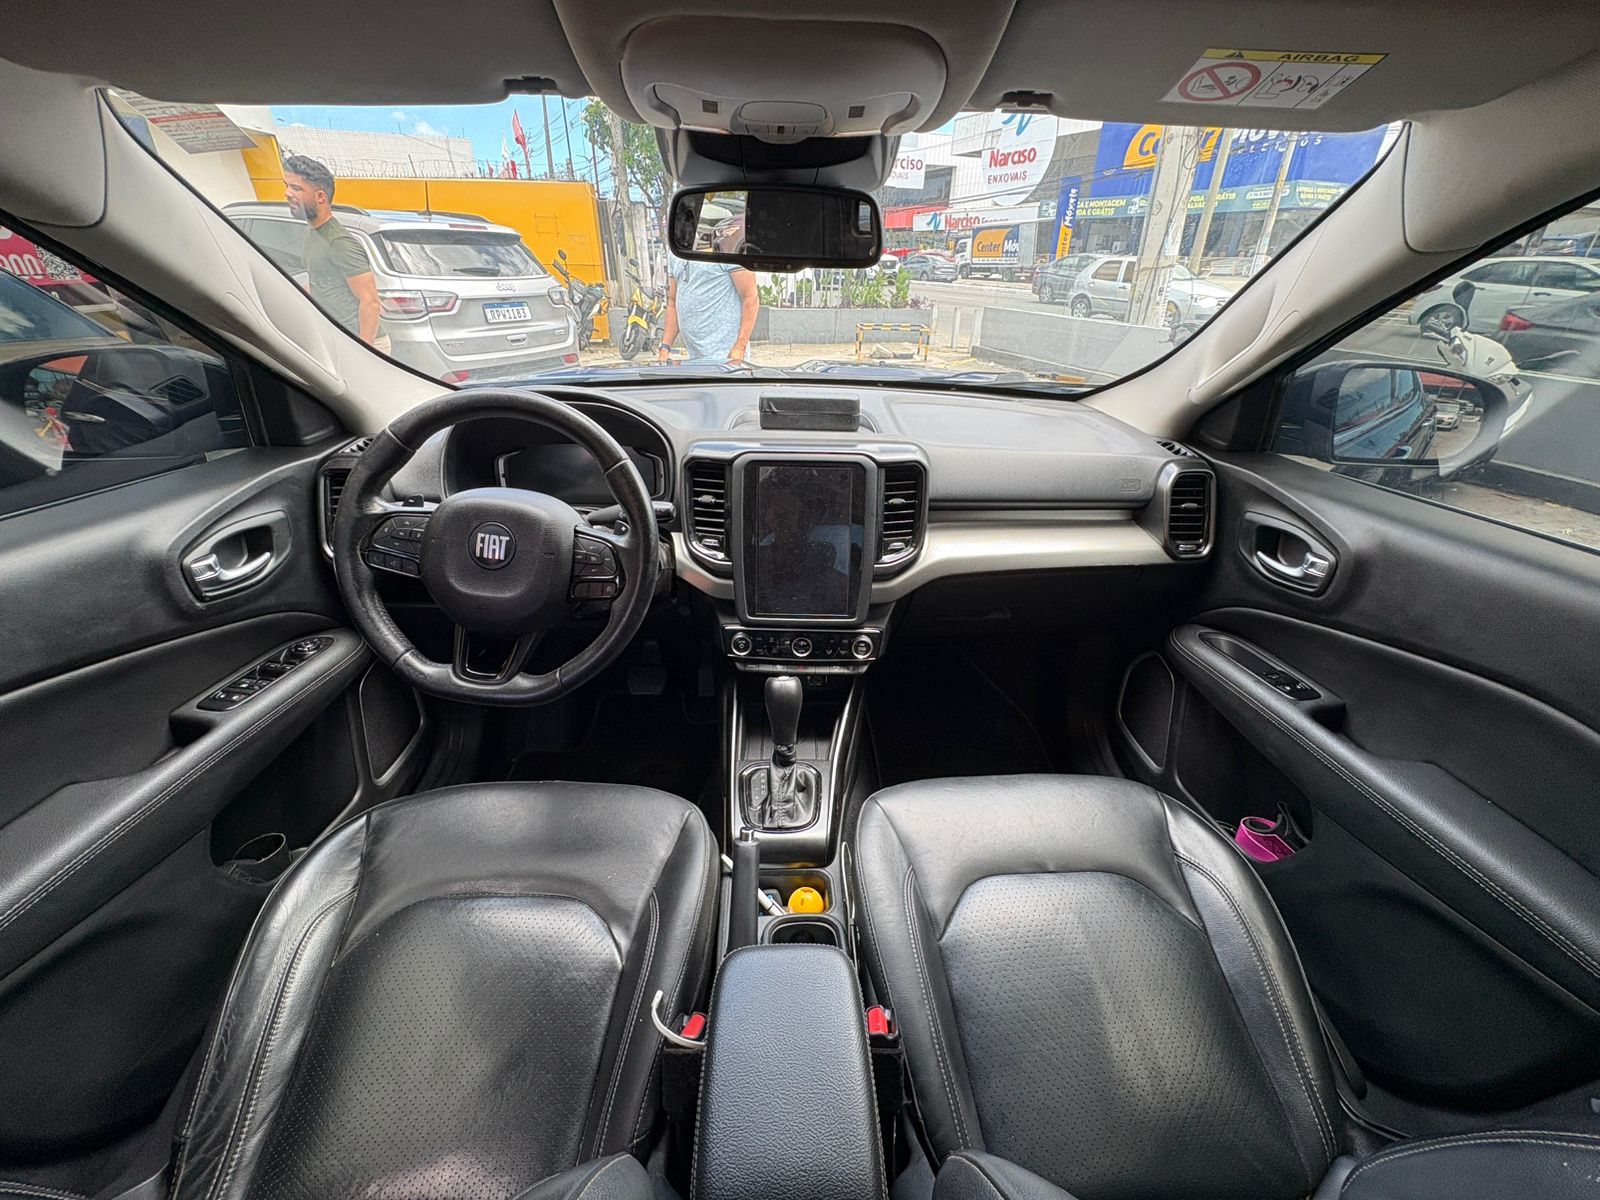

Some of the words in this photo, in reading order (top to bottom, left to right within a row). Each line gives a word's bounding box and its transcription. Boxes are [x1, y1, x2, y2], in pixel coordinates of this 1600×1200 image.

[1280, 52, 1360, 63] AIRBAG
[989, 147, 1037, 168] Narciso
[987, 170, 1028, 184] ENXOVAIS
[1089, 199, 1126, 208] MONTAGEM
[944, 212, 980, 228] Narciso
[977, 241, 1001, 252] Center
[474, 533, 510, 560] FIAT
